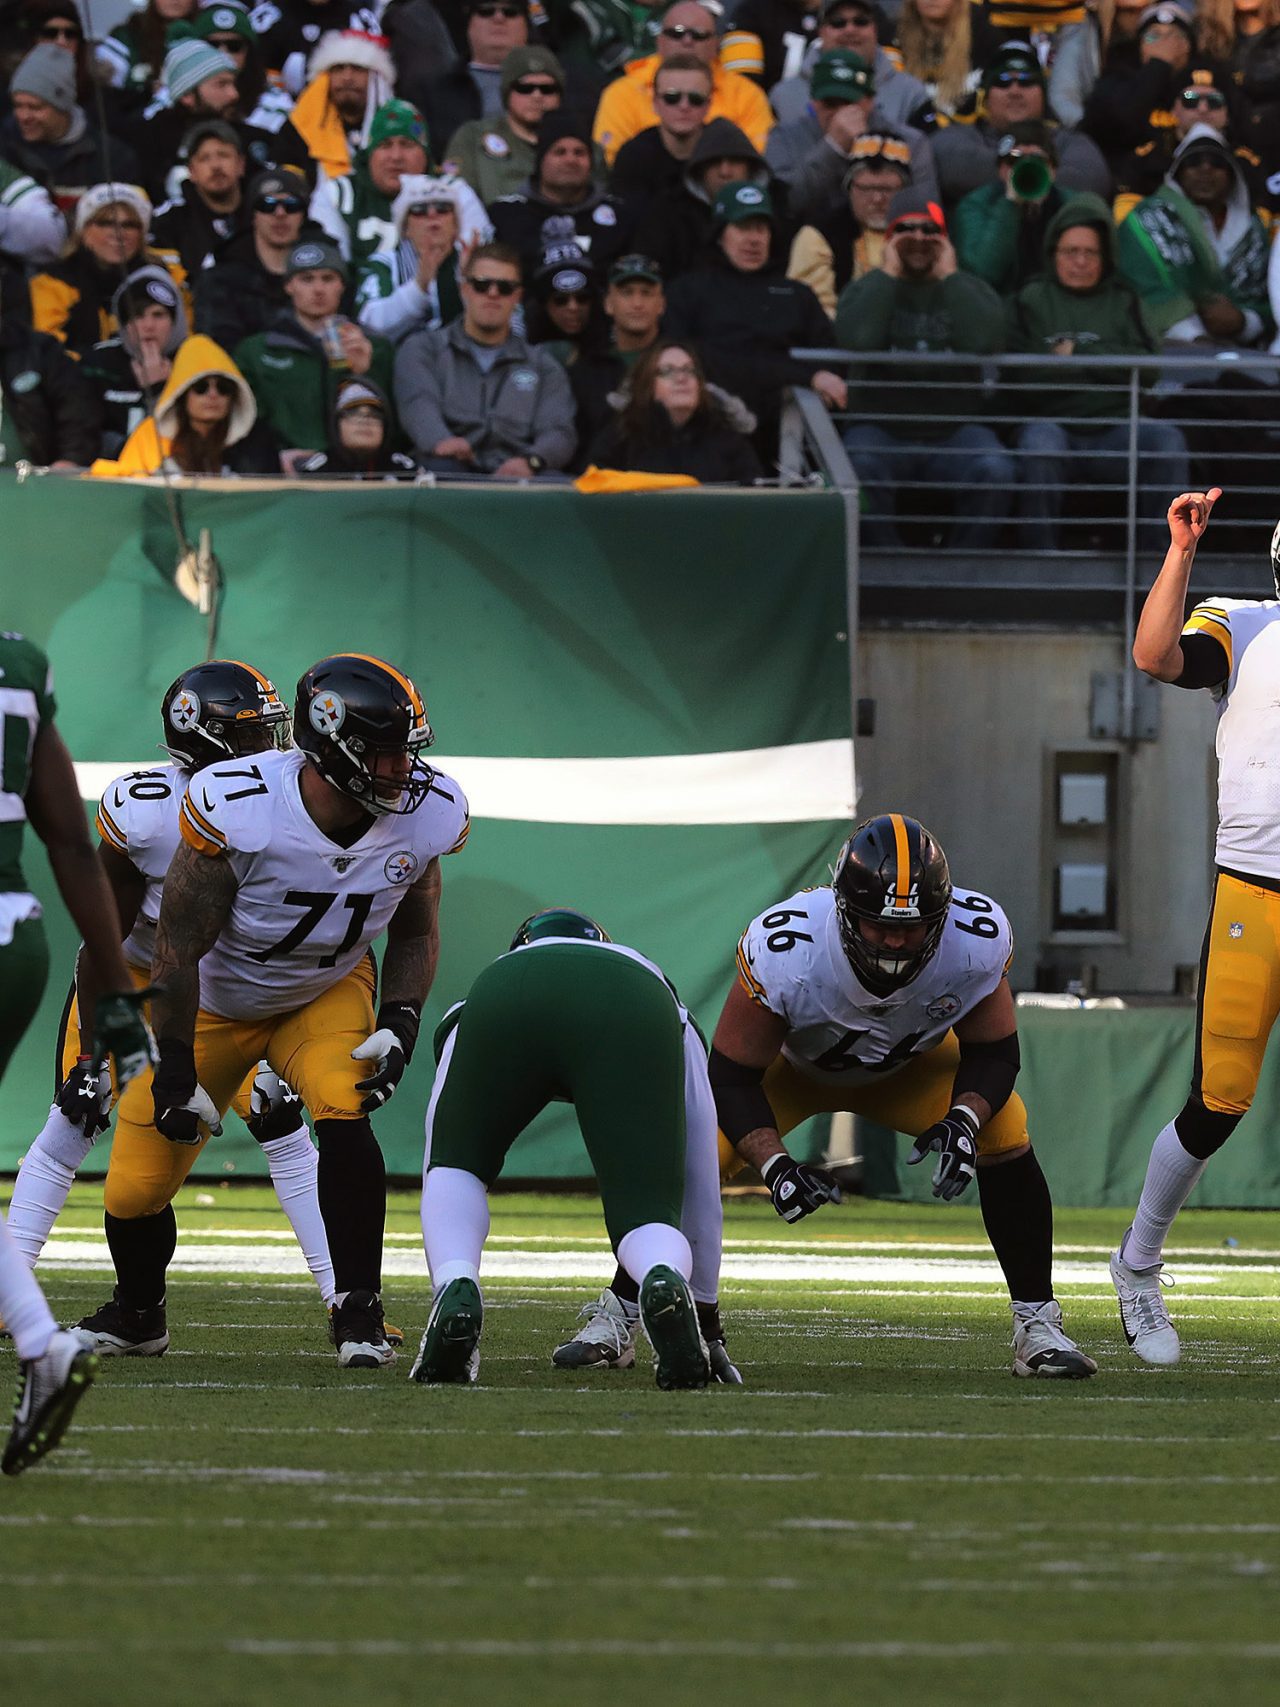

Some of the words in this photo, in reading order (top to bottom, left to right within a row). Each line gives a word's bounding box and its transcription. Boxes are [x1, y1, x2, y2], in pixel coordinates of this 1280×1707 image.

[212, 765, 269, 802] 71
[245, 891, 375, 969] 71
[762, 910, 815, 953] 66
